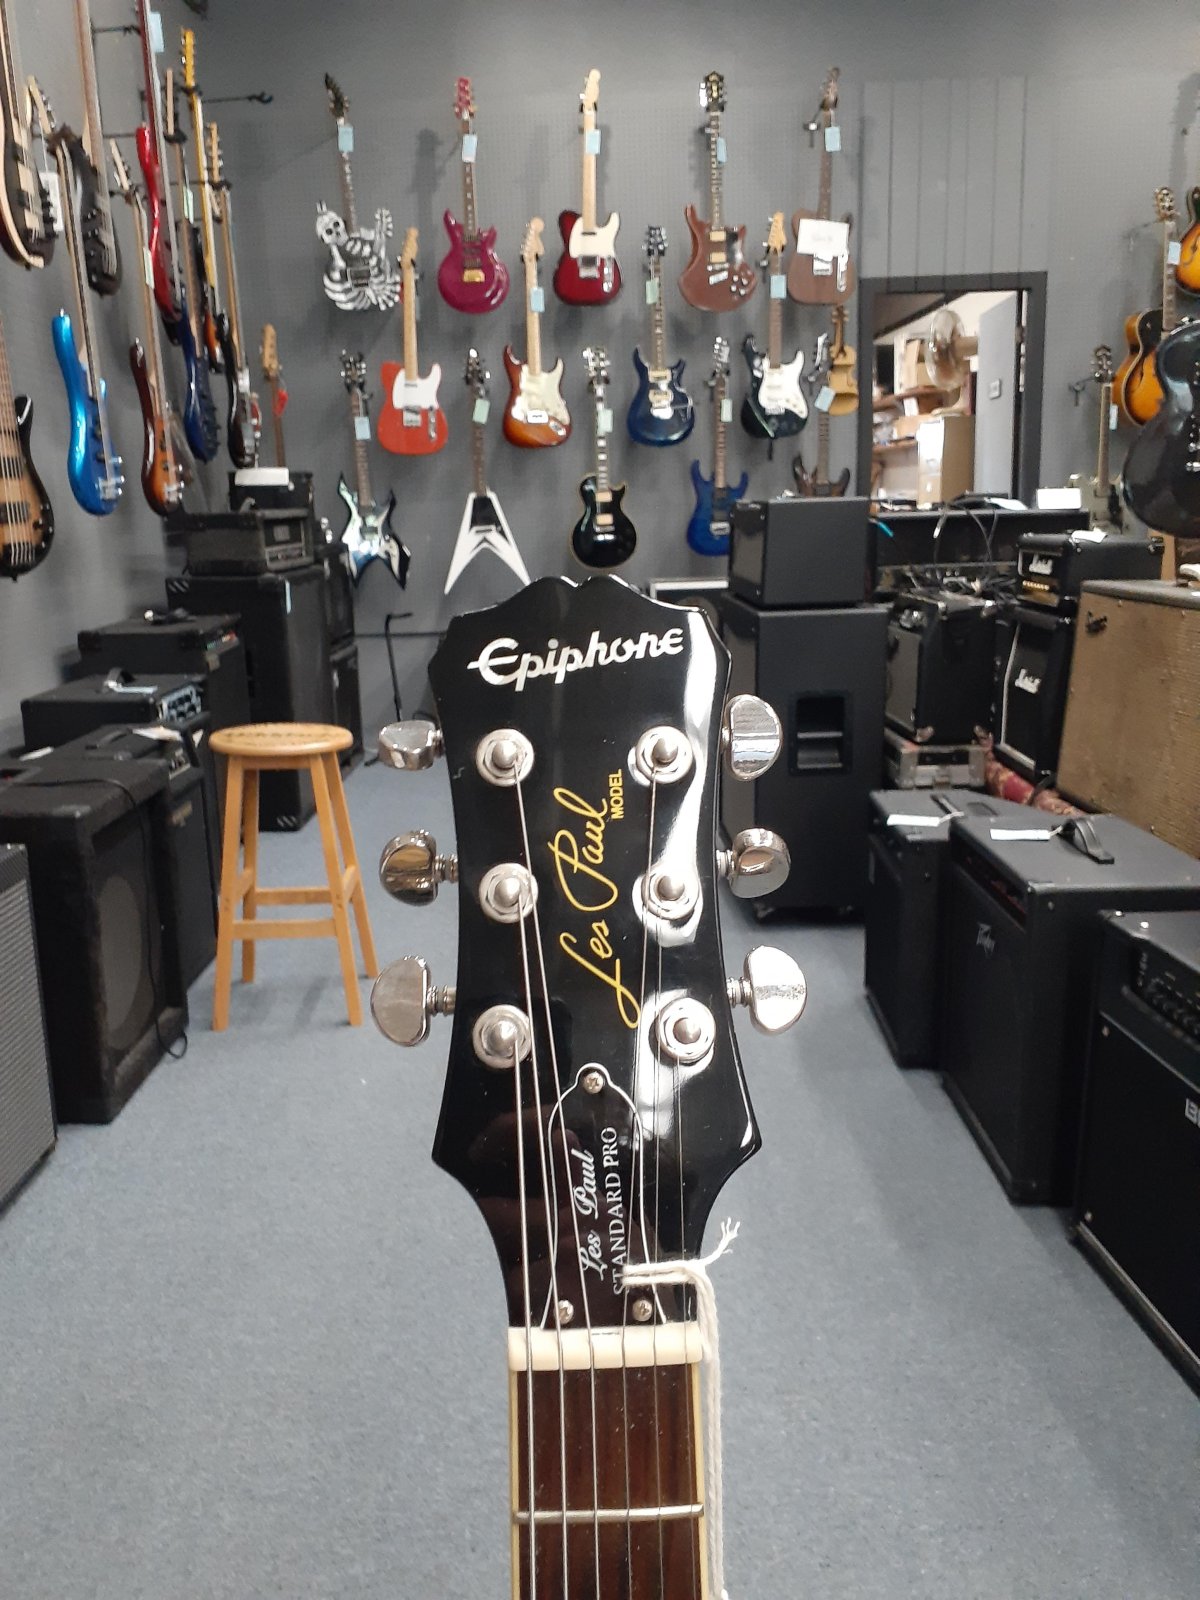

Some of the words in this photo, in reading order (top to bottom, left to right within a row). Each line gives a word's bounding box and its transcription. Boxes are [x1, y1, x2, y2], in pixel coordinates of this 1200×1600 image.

[467, 628, 684, 692] Epiphone
[608, 768, 624, 820] MODEL
[547, 787, 619, 912] Paul
[559, 919, 641, 1029] Les
[600, 1126, 619, 1168] PRO
[571, 1148, 599, 1220] Paul
[578, 1230, 608, 1281] Les
[605, 1172, 630, 1296] STANDARD
